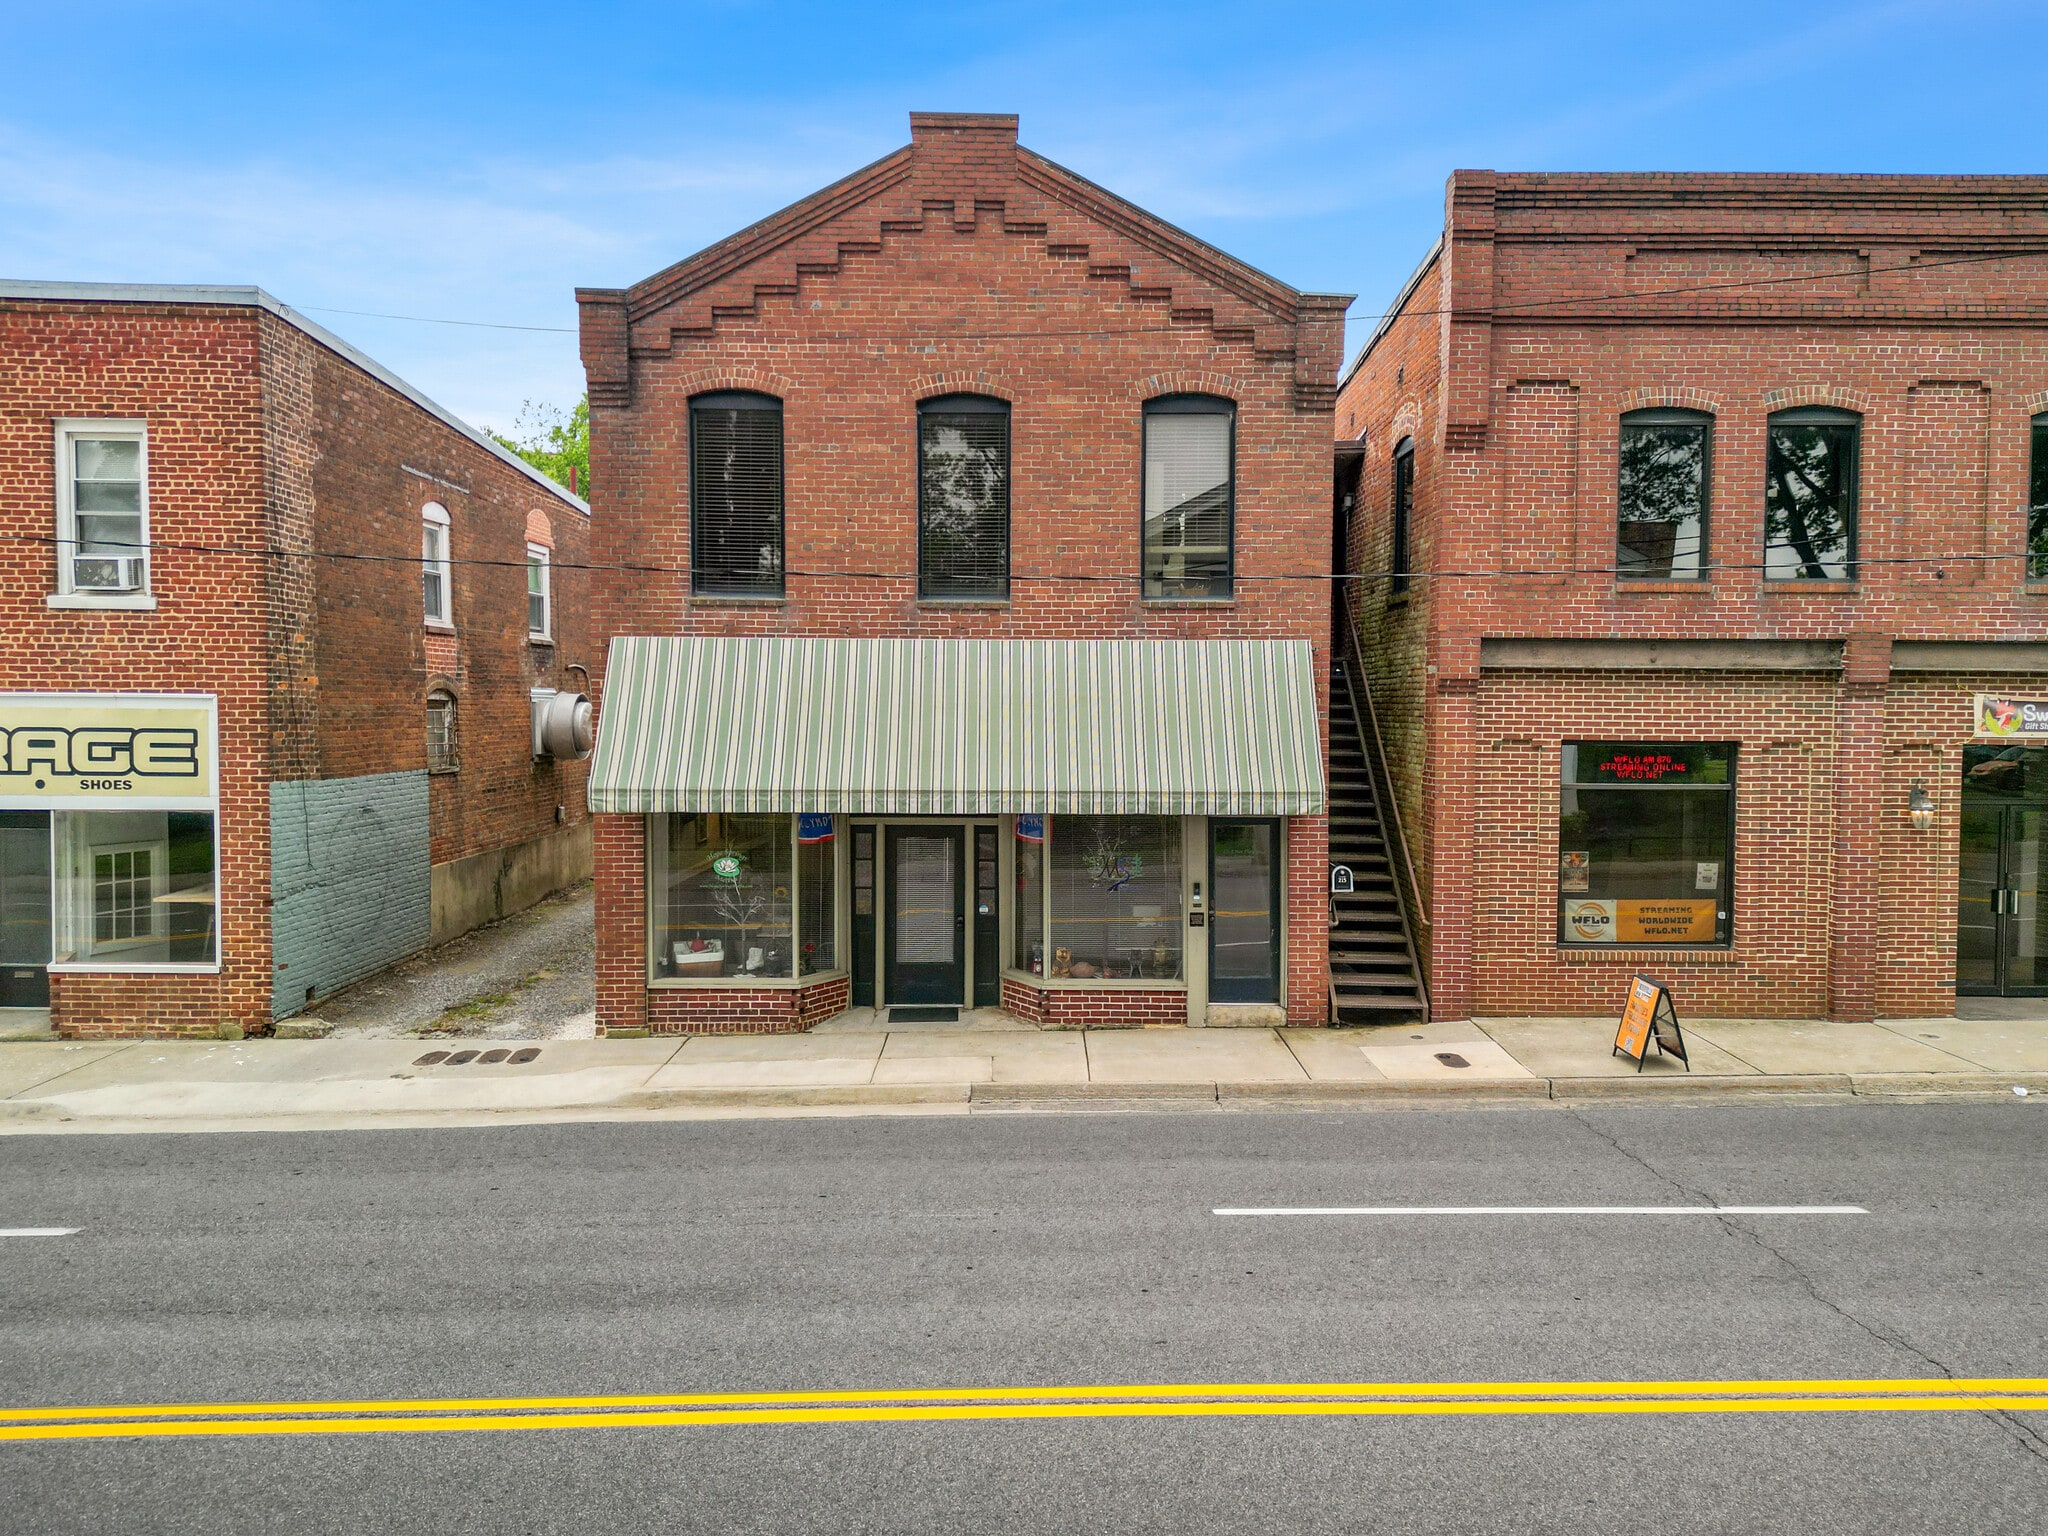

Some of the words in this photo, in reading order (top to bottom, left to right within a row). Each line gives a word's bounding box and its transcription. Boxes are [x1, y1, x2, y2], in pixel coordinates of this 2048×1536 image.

[2024, 722, 2038, 730] Gift
[0, 727, 198, 777] AGE
[1614, 755, 1640, 764] WFLO
[1600, 763, 1649, 771] STREAMING
[1653, 763, 1686, 772] ONLINE
[80, 780, 133, 790] SHOES
[1571, 916, 1610, 925] WFLO
